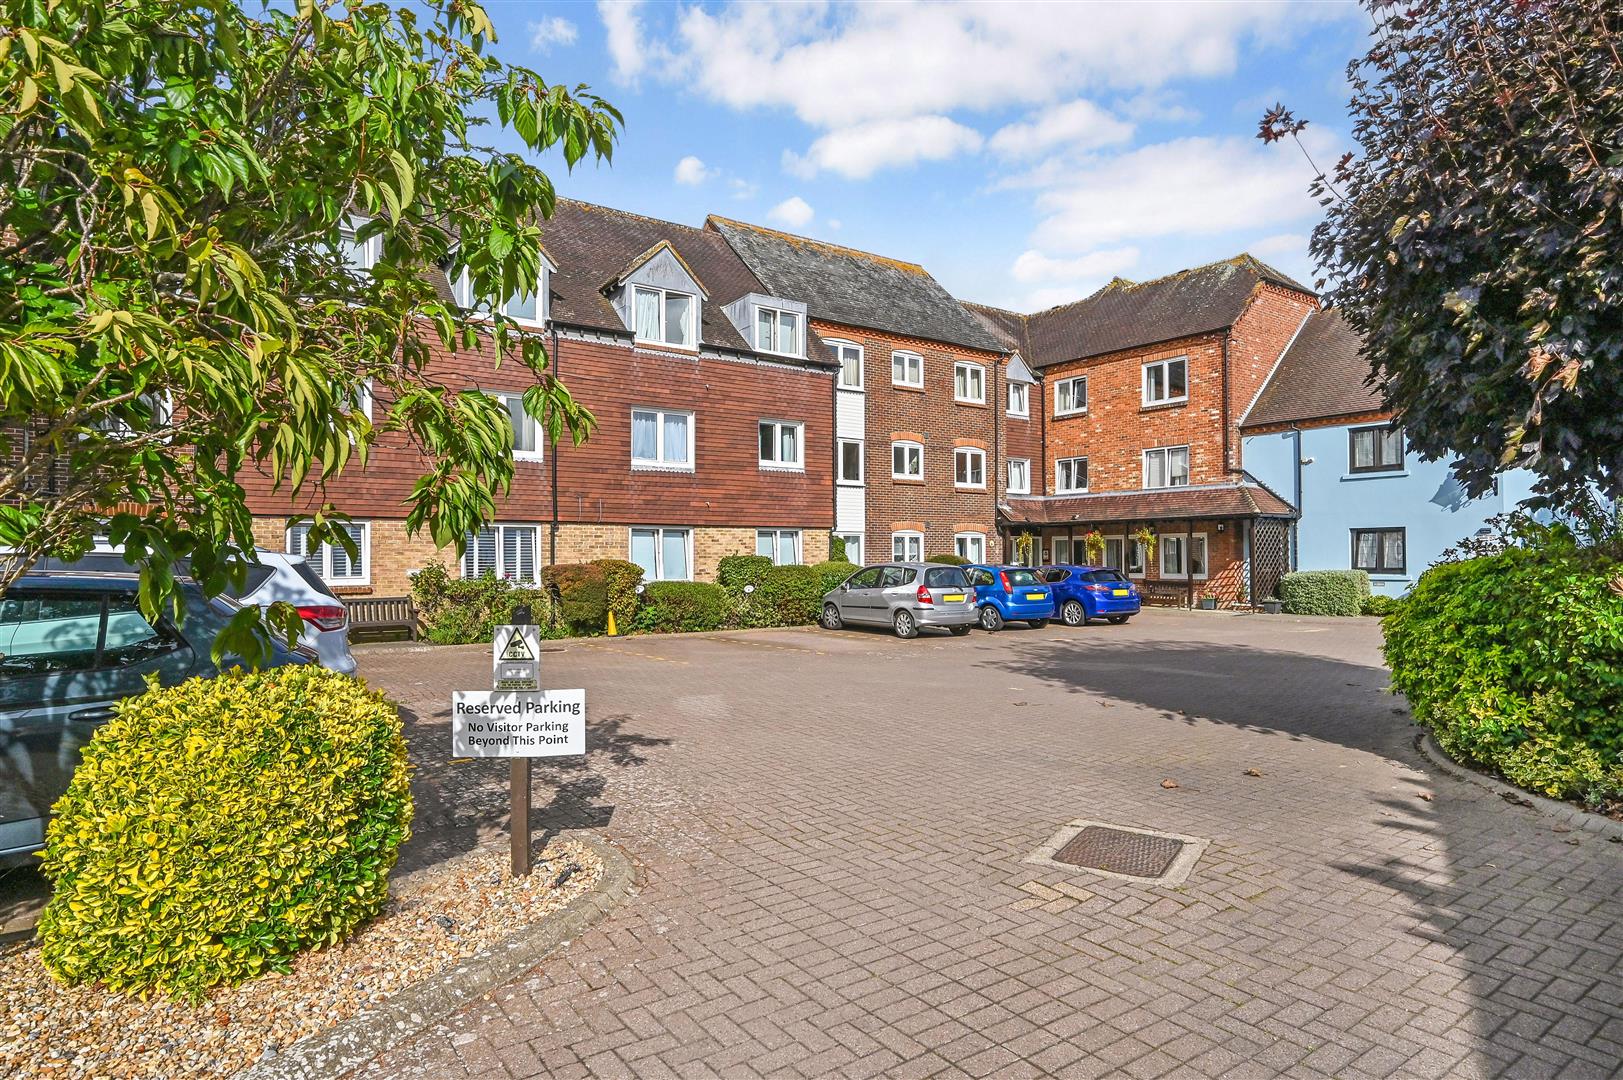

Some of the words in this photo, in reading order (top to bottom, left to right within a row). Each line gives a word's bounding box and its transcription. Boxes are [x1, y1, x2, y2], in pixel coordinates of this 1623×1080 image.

[456, 701, 521, 715] Reserved
[526, 700, 581, 715] Parking
[468, 722, 484, 732] No
[487, 722, 523, 732] Visitor
[526, 721, 569, 733] Parking
[468, 735, 510, 748] Beyond
[513, 735, 535, 746] This
[539, 734, 569, 745] Point
